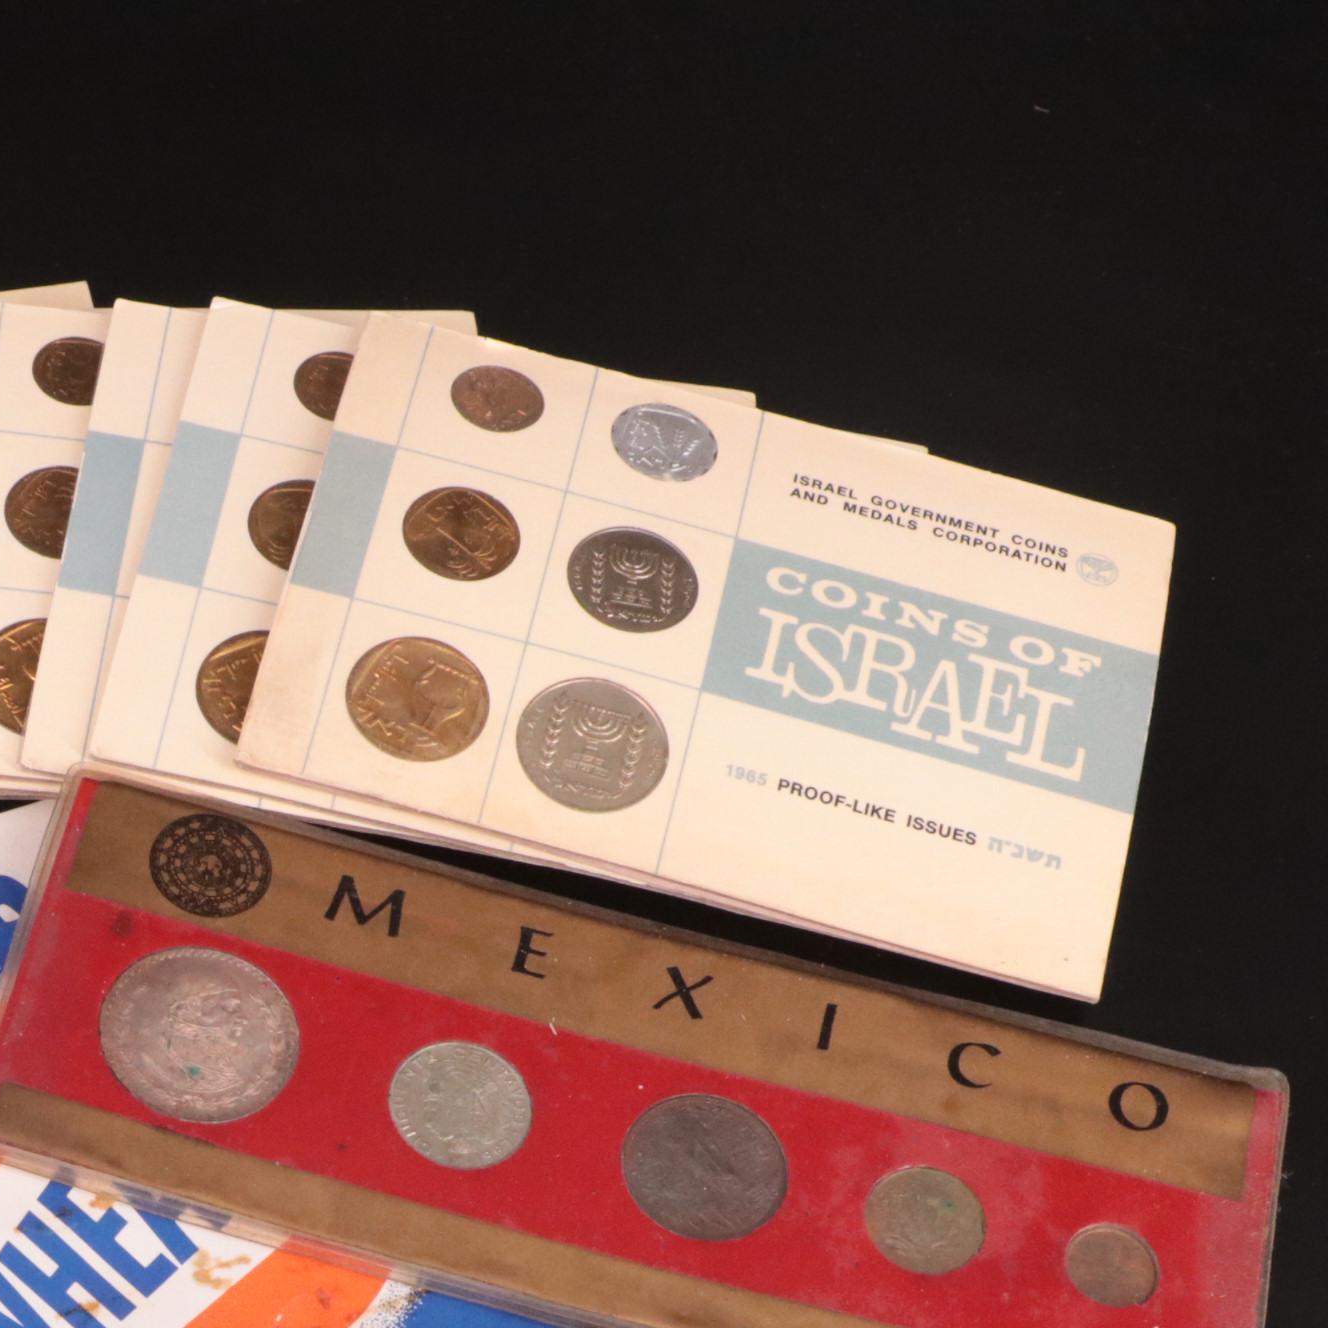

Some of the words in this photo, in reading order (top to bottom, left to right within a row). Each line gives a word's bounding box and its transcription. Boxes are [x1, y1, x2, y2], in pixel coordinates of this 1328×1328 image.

[790, 487, 829, 507] AND
[842, 500, 919, 531] MEDALS
[932, 526, 1068, 573] CORPORATION
[792, 473, 859, 500] ISRAEL
[870, 494, 1001, 538] GOVERNMENT
[1011, 533, 1069, 559] COINS
[765, 566, 989, 649] COINS
[1009, 631, 1103, 679] OF
[745, 606, 1087, 783] ISRAEL
[725, 763, 769, 787] 1965
[777, 778, 897, 825] PROOF-LIKE
[906, 814, 978, 847] ISSUES
